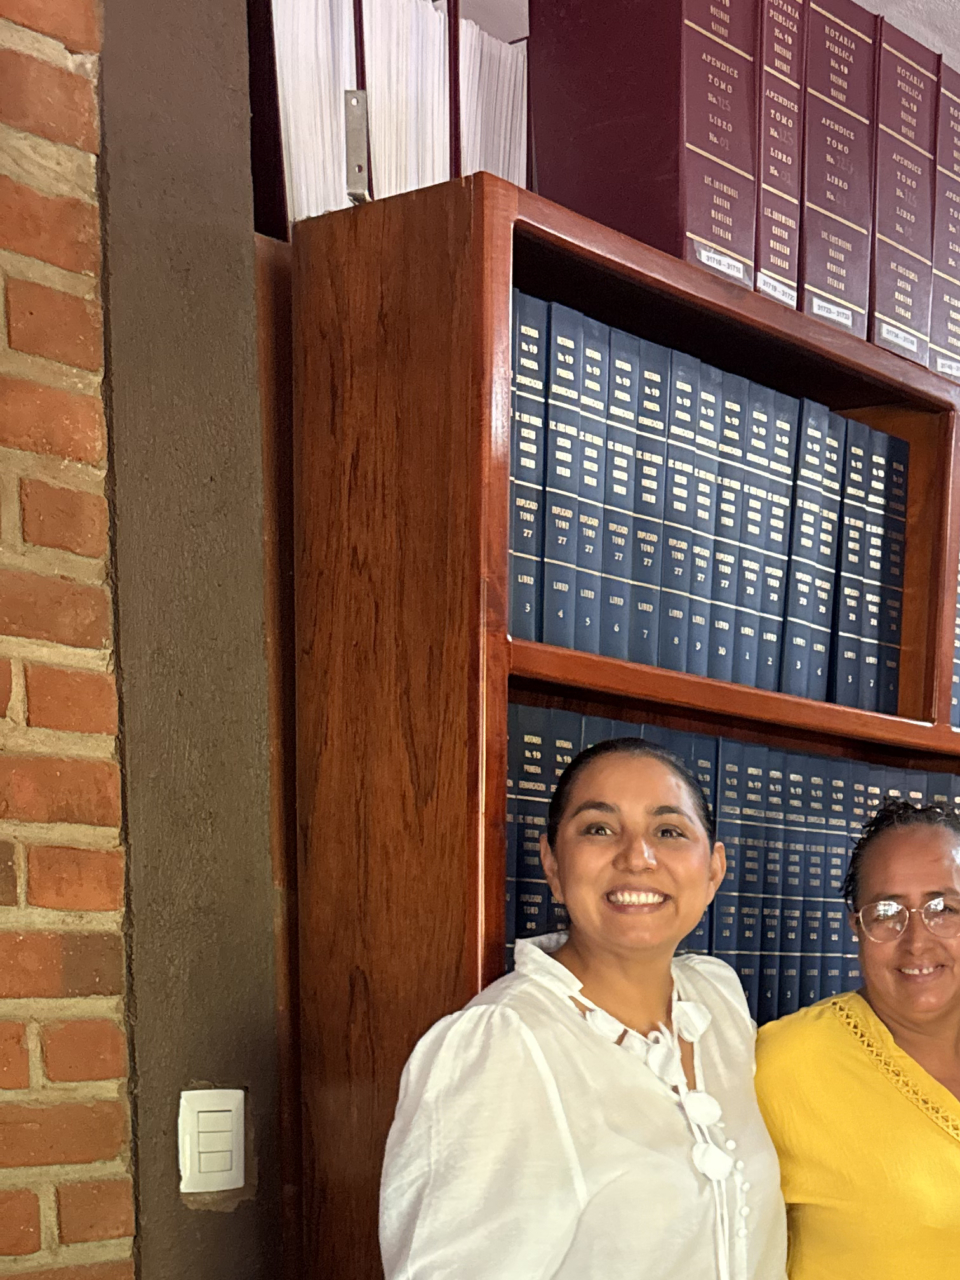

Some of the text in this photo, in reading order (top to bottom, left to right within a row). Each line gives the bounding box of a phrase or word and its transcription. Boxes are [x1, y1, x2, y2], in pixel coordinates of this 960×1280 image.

[769, 9, 798, 33] PUBLICA
[825, 25, 855, 50] NOTARIA
[825, 41, 853, 63] PUBLICA
[702, 53, 738, 78] APENDICE
[708, 74, 732, 94] TOMO
[766, 89, 798, 112] APENDICE
[771, 109, 793, 127] TOMO
[822, 117, 854, 140] APENDICE
[827, 137, 849, 154] TOMO
[525, 604, 530, 612] 3
[614, 624, 619, 632] 6
[643, 630, 648, 638] 7
